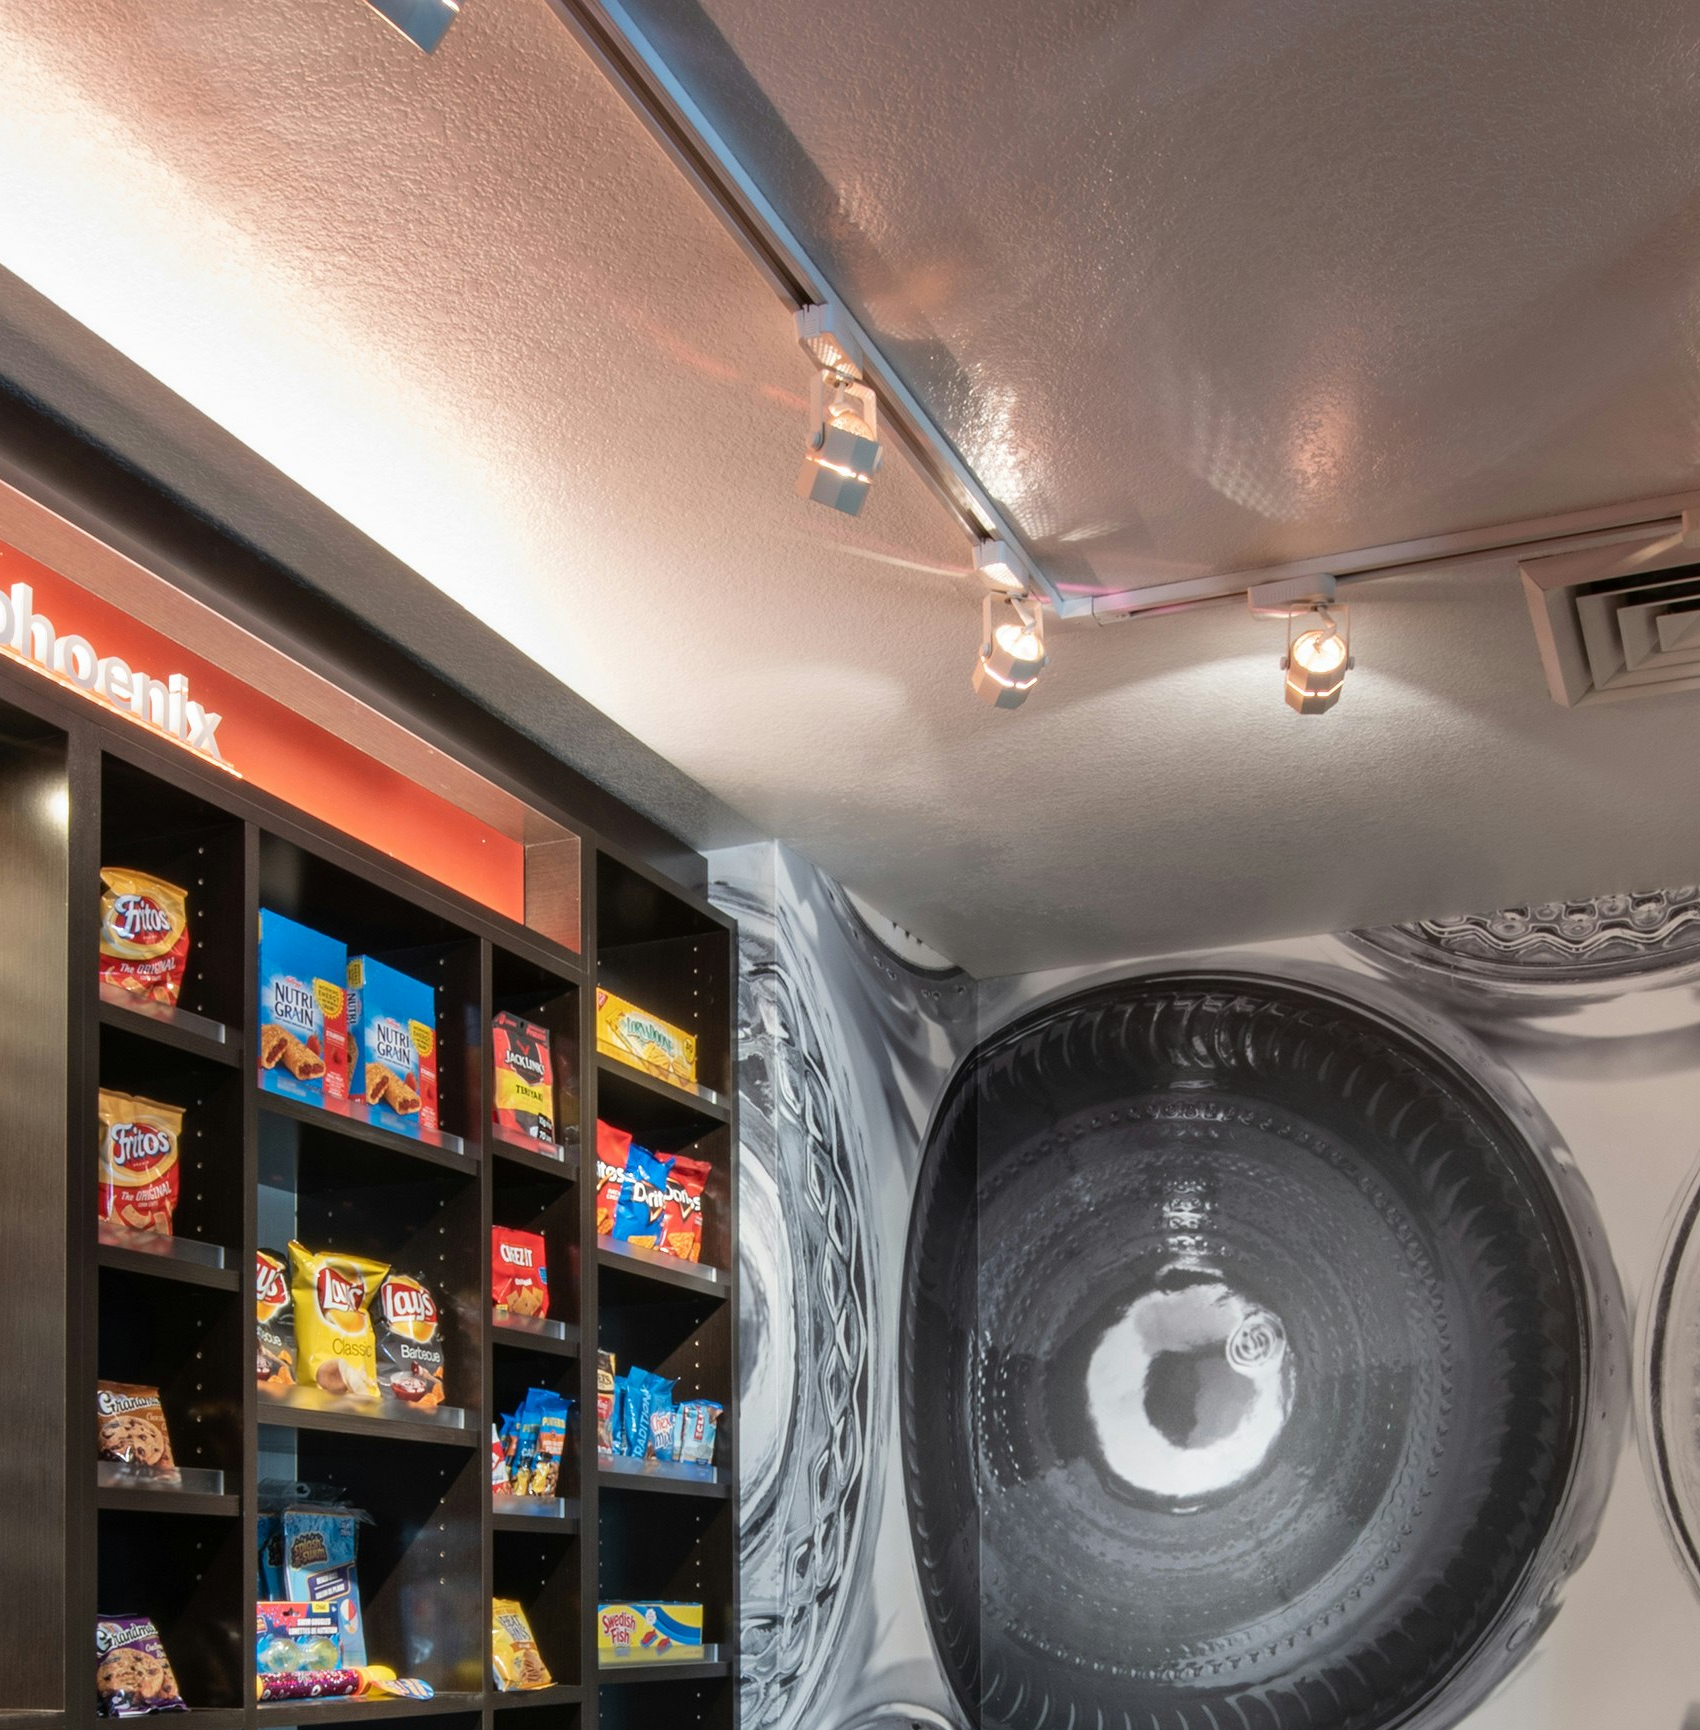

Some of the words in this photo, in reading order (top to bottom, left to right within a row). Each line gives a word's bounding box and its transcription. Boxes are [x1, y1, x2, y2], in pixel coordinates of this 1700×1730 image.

[114, 894, 171, 938] Fritos
[119, 962, 135, 974] The
[274, 982, 314, 1009] NUTRI
[274, 1003, 314, 1028] GRAIN
[377, 1023, 411, 1048] NUTRI
[376, 1041, 411, 1065] GRAIN
[110, 1122, 170, 1165] Fritos
[332, 1338, 373, 1358] Classic
[401, 1344, 441, 1363] Barbecue
[602, 1612, 636, 1634] Swedish
[610, 1628, 630, 1644] Fish
